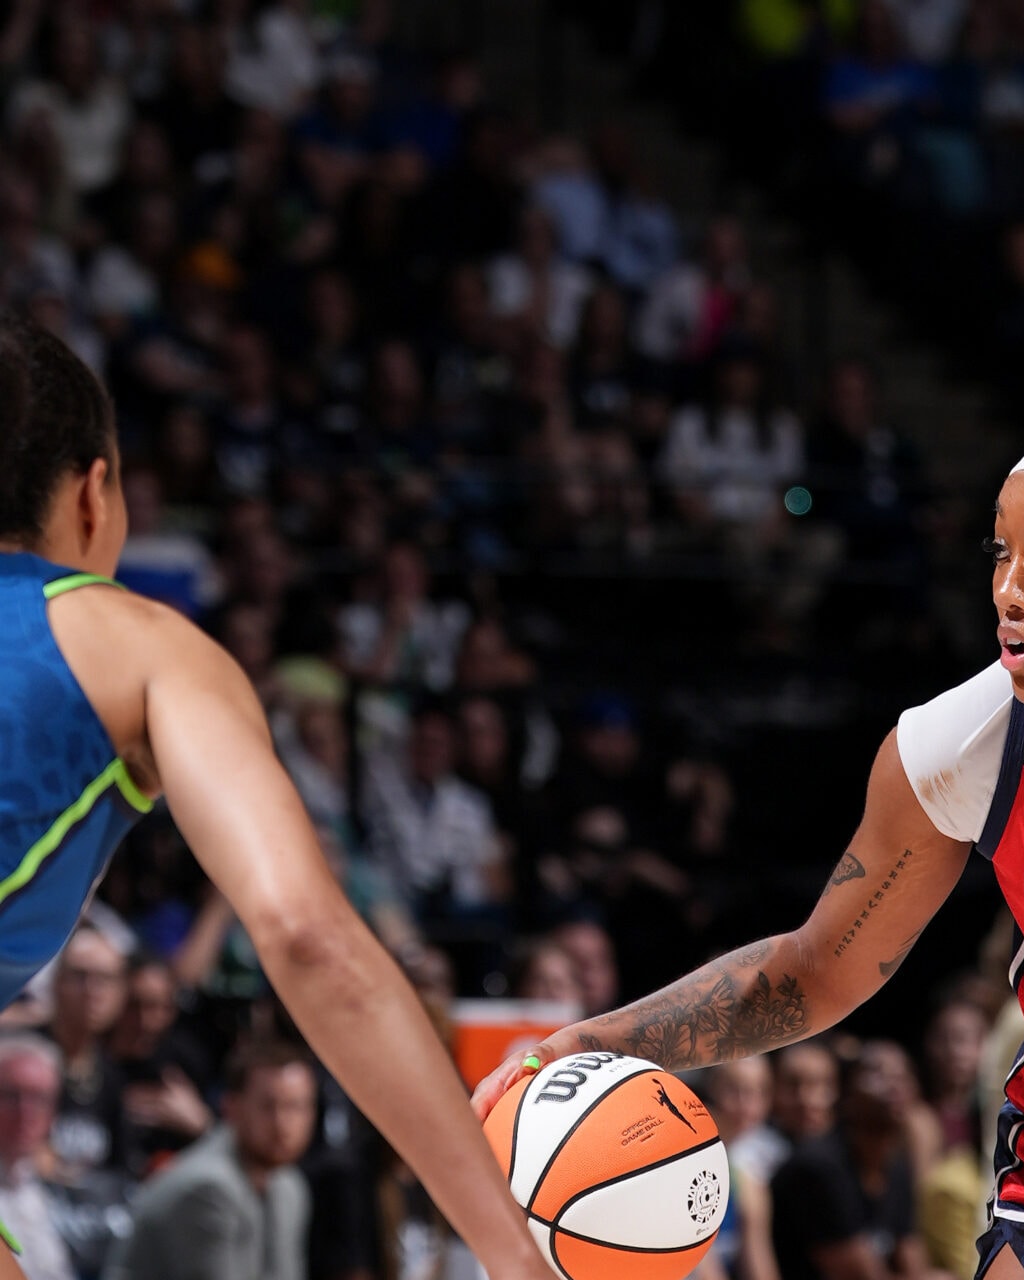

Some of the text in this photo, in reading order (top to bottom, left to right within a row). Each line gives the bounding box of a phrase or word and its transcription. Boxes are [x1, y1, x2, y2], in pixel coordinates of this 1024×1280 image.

[621, 1114, 656, 1137] OFFICIAL
[621, 1129, 646, 1147] GAME
[645, 1119, 665, 1132] BALL
